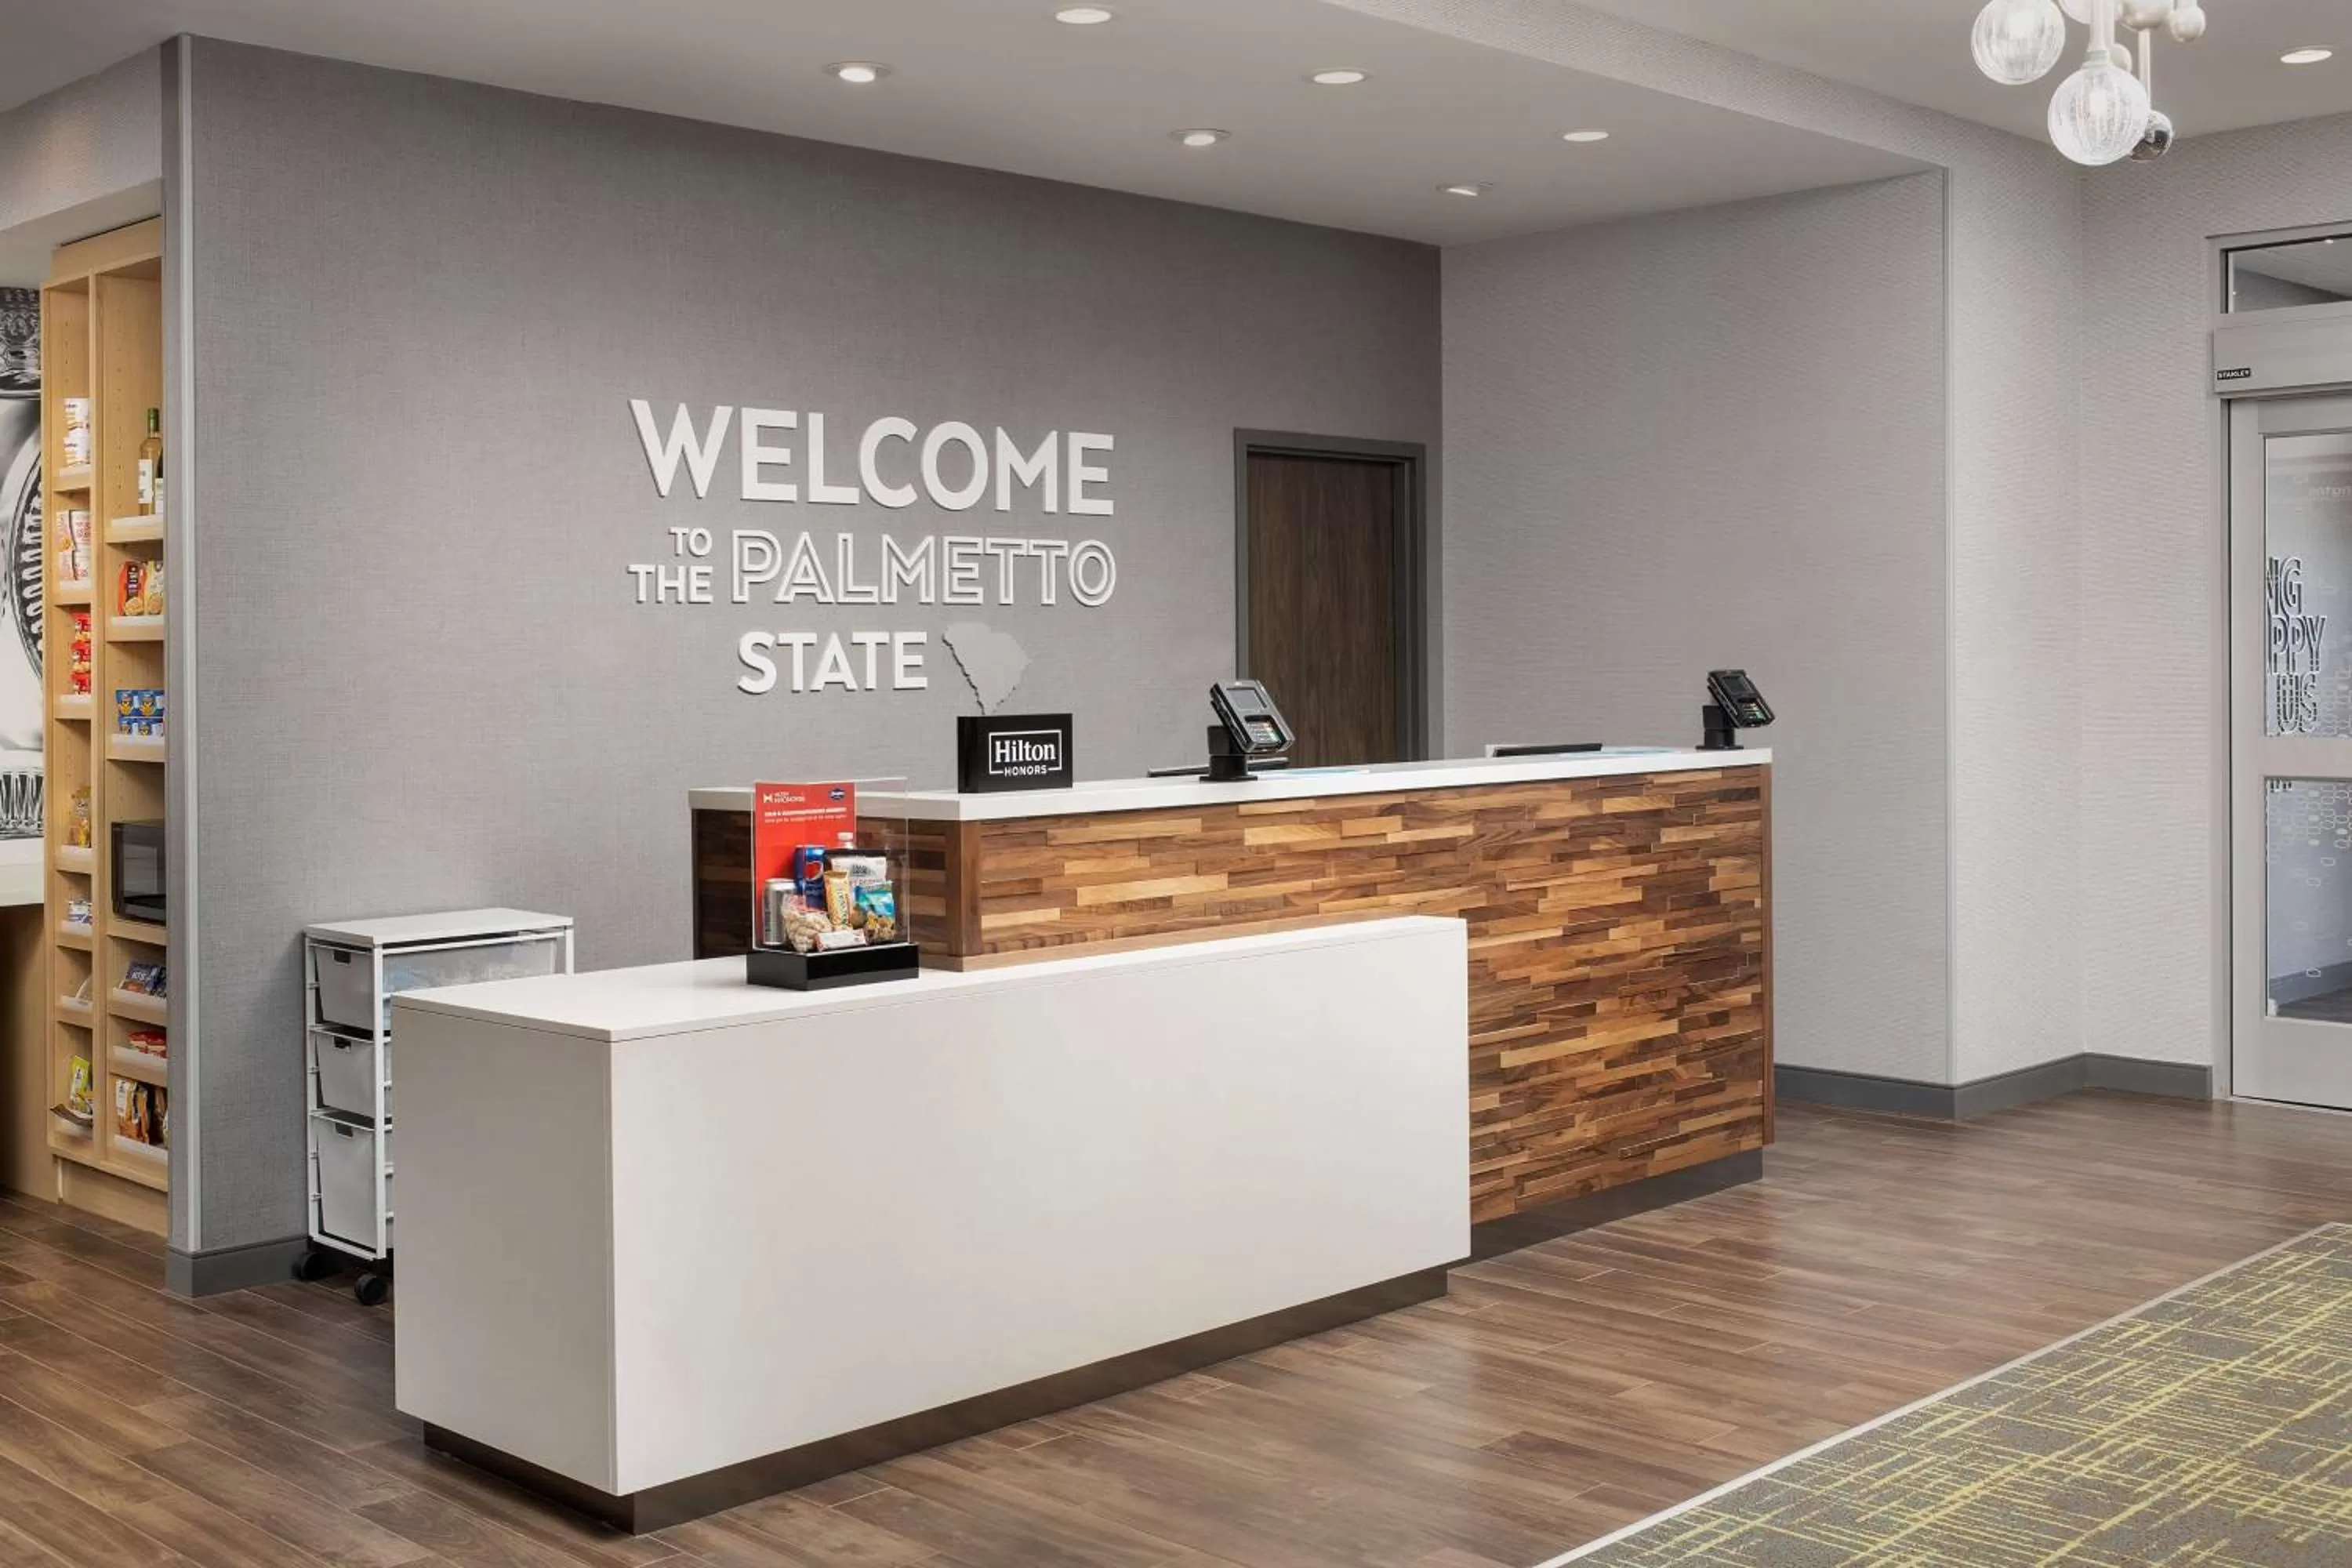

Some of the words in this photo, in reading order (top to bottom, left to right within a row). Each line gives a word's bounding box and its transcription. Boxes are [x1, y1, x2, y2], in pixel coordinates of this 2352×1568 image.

[630, 398, 1114, 516] WELCOME
[667, 527, 713, 557] TO
[627, 564, 713, 603] THE
[731, 529, 1117, 607] PALMETTO
[736, 631, 928, 695] STATE
[995, 739, 1056, 763] Hilton
[1004, 764, 1047, 777] HONORS
